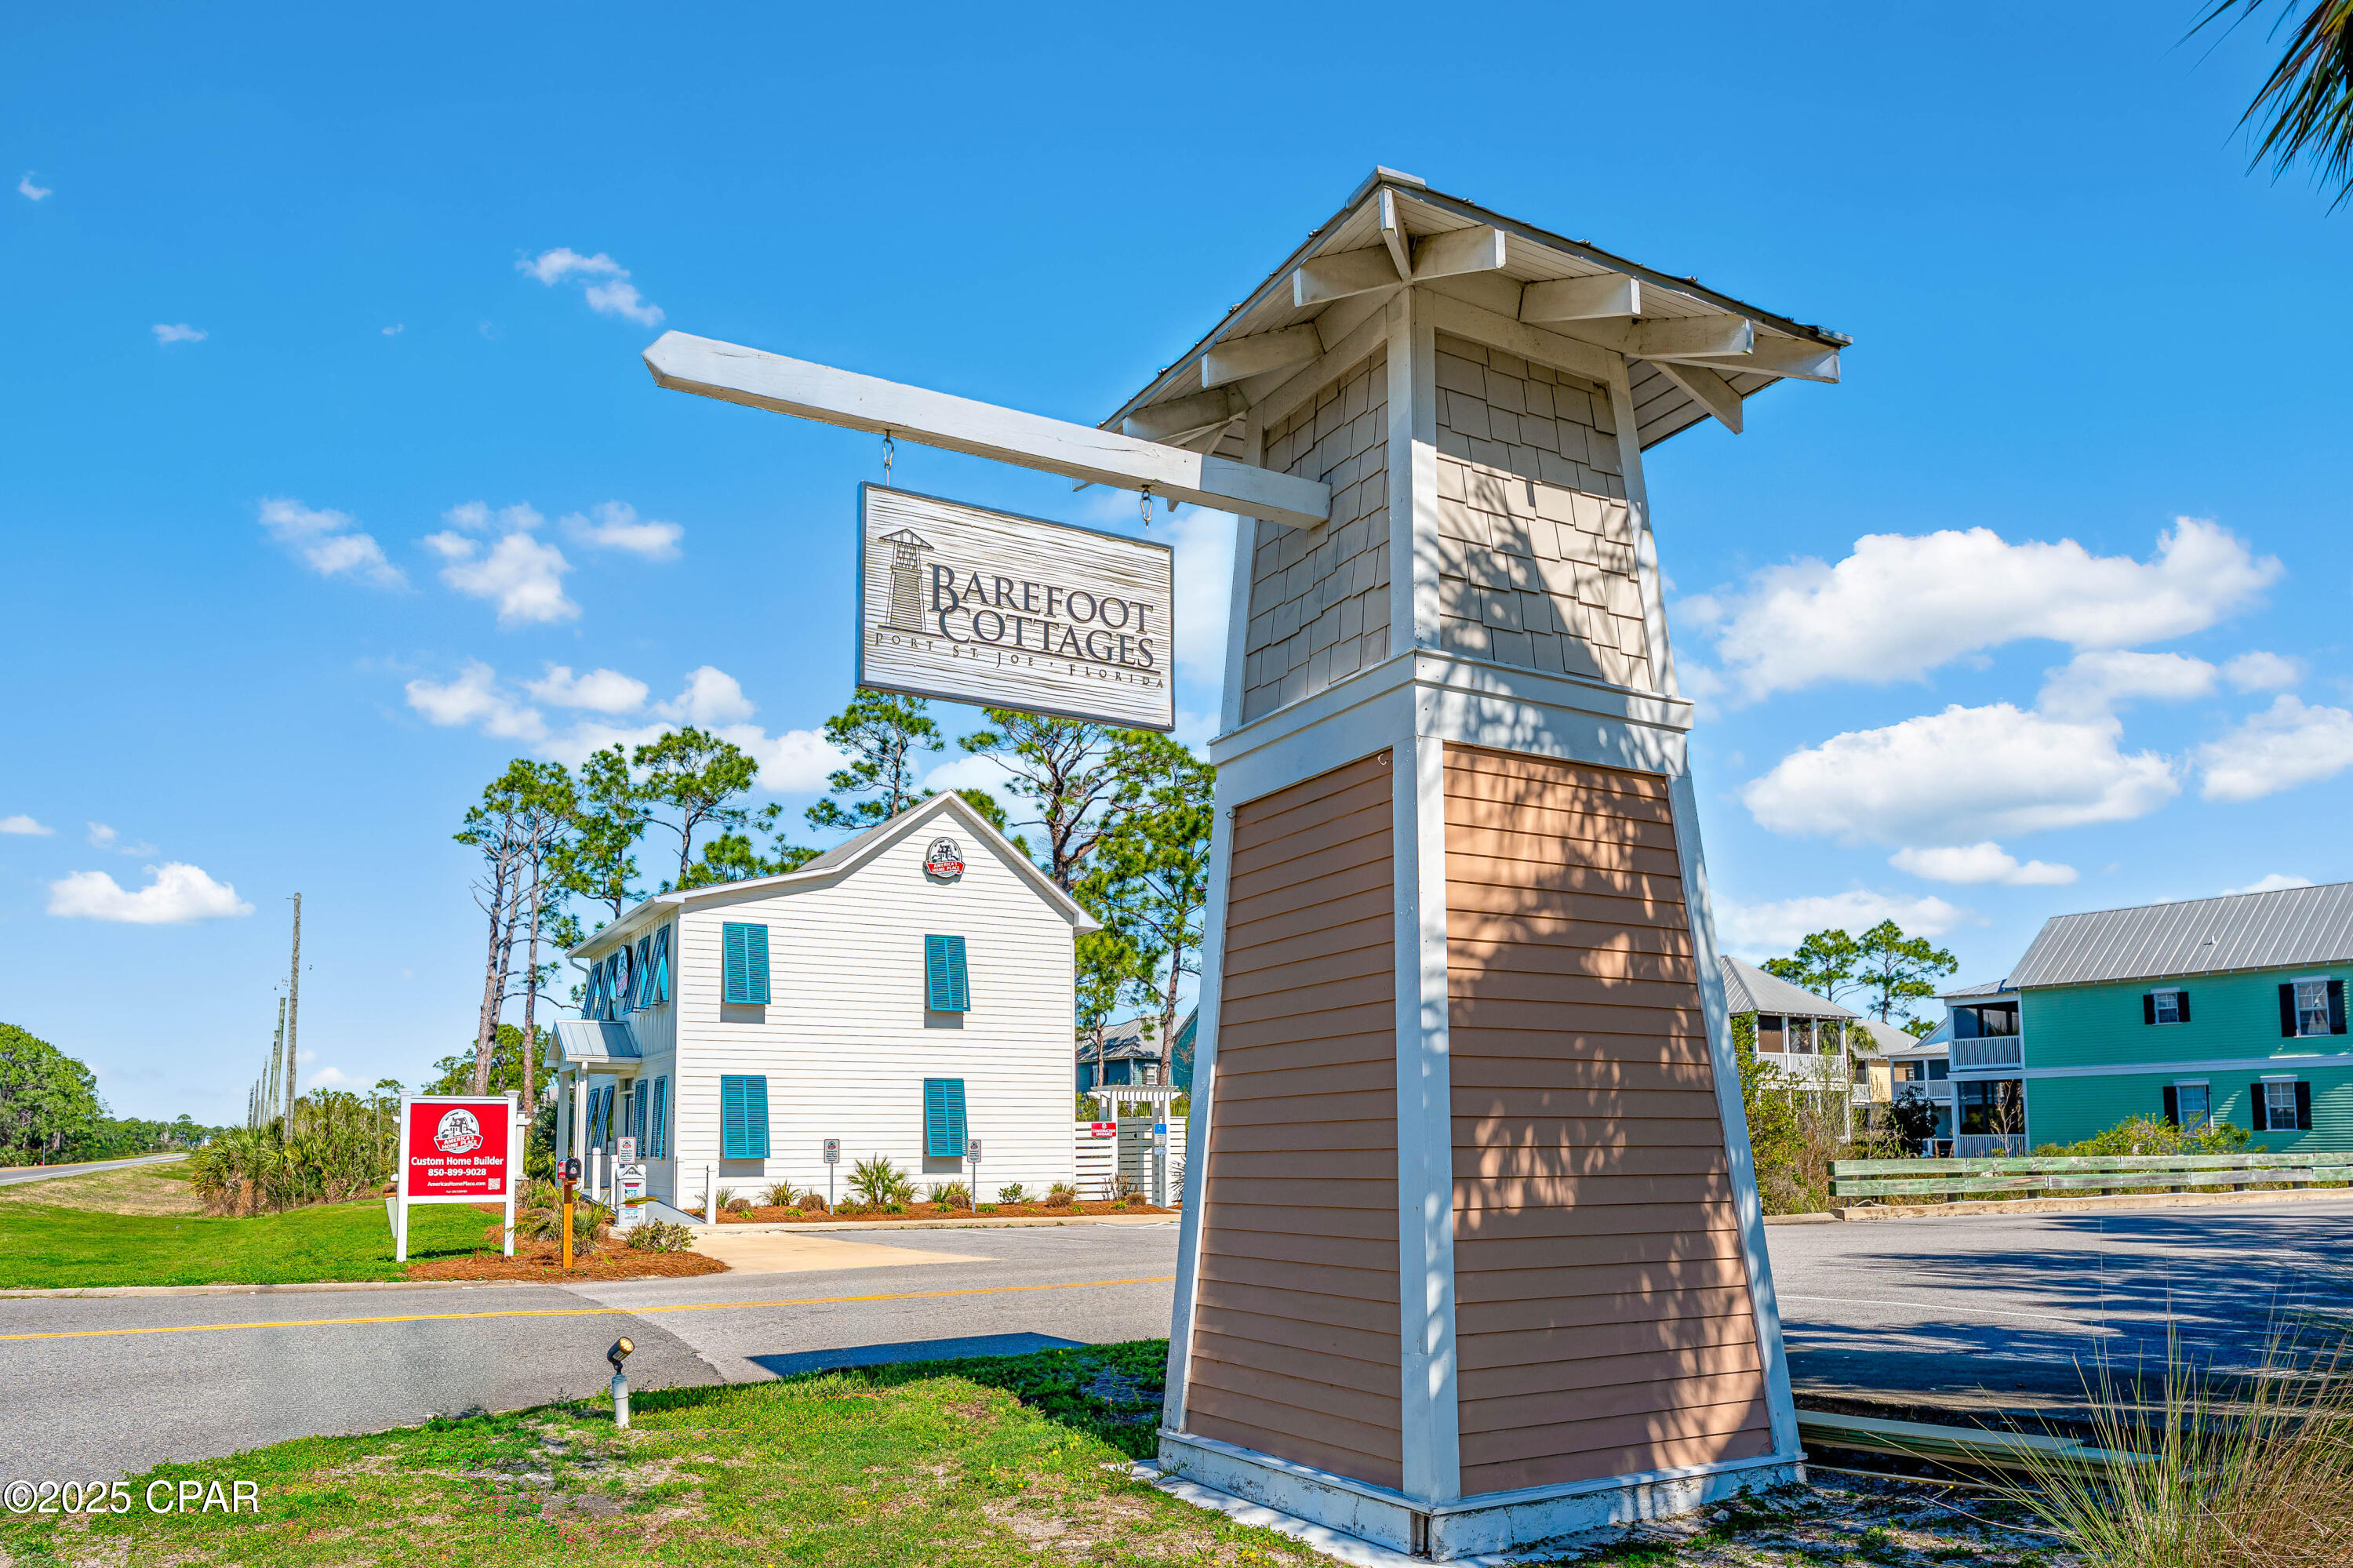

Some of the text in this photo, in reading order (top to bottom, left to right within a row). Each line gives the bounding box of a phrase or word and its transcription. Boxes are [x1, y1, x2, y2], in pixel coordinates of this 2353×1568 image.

[927, 562, 1154, 635] BAREFOOT
[938, 605, 1155, 668] COTTAGES
[874, 632, 933, 650] PORT
[1068, 664, 1164, 689] FLORIDA
[443, 1135, 475, 1144] AMERICA'S
[460, 1139, 478, 1148] PLACE
[411, 1156, 504, 1166] Custom Home Builder
